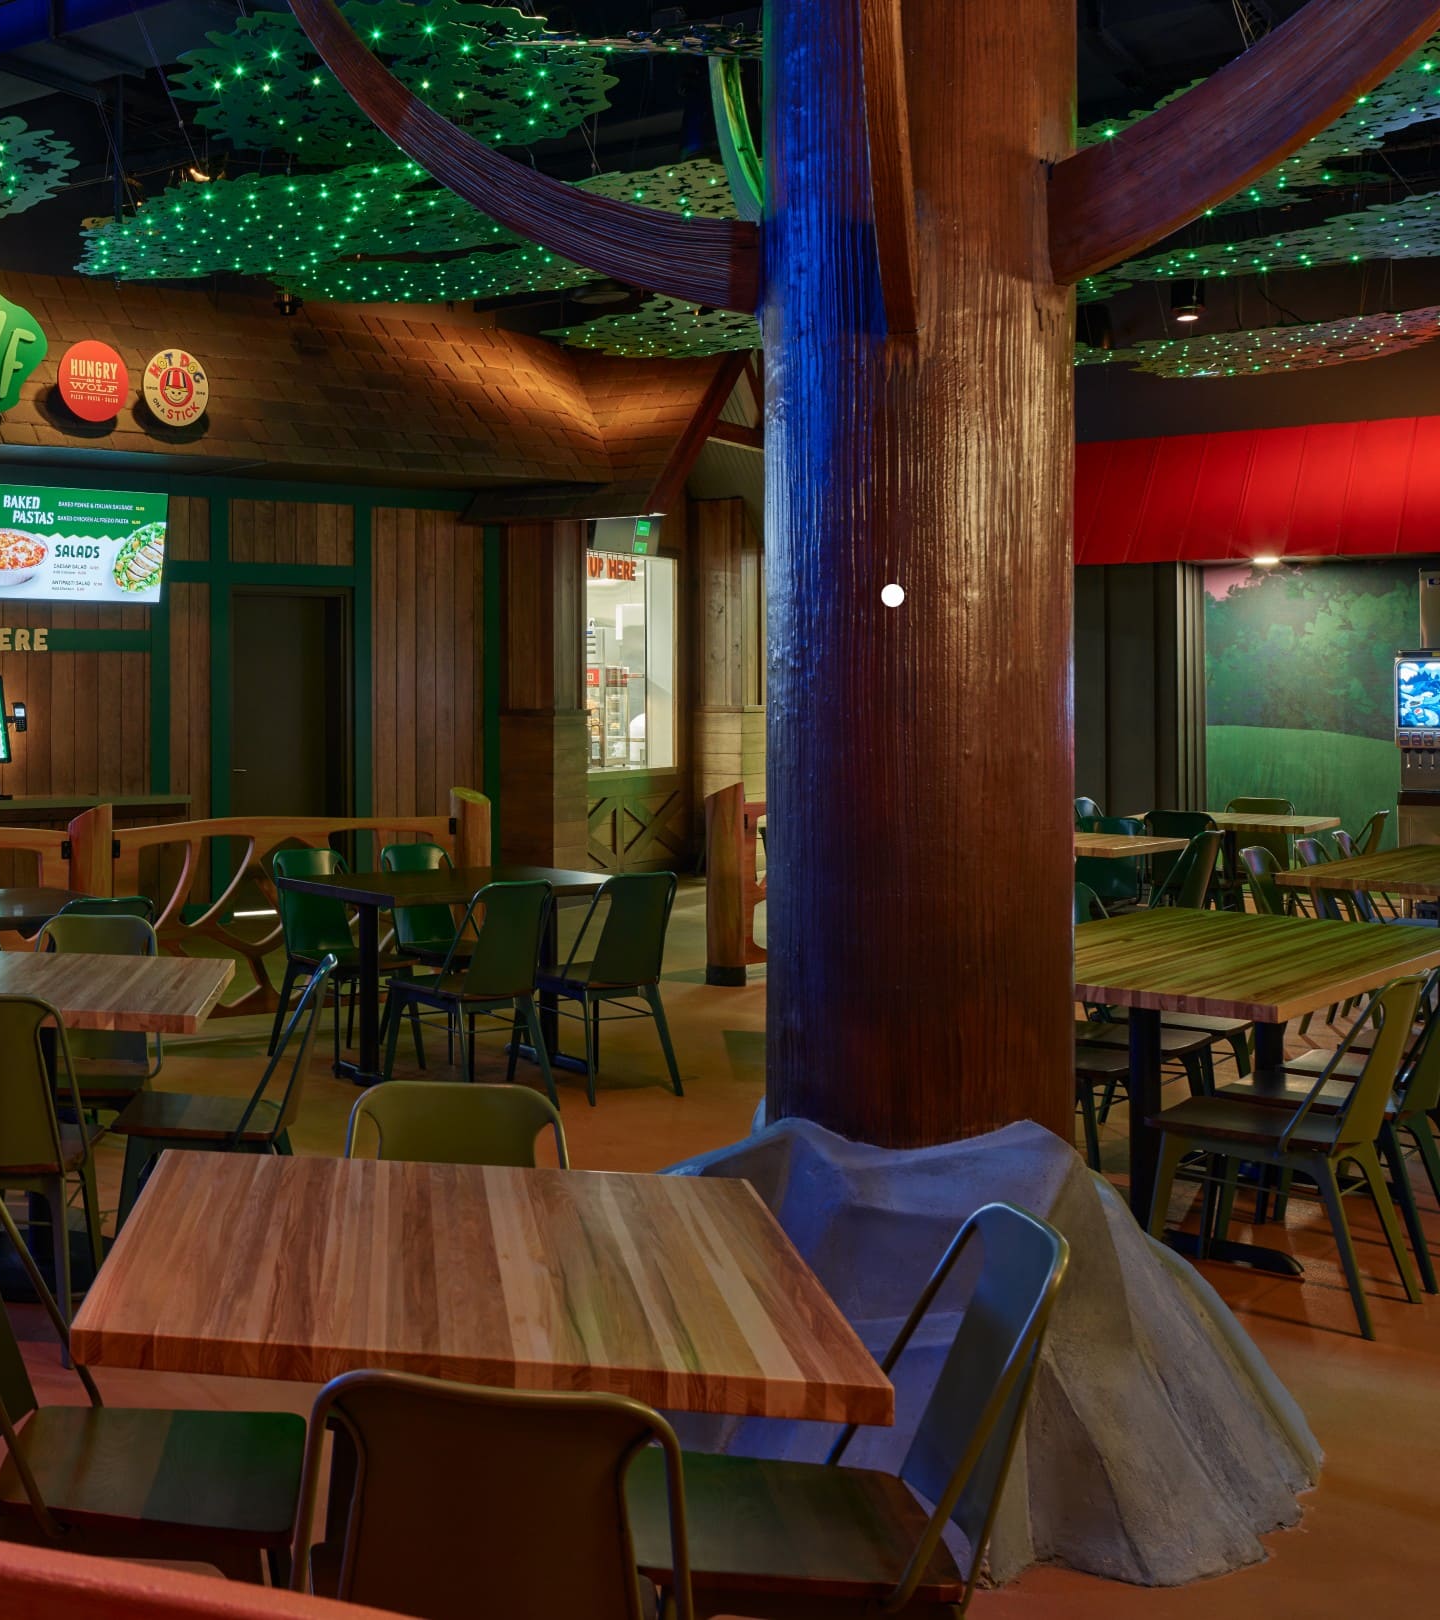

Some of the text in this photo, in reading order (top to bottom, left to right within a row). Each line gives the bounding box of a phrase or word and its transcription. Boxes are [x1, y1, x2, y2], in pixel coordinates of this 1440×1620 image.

[70, 358, 118, 380] HUNGRY
[148, 353, 205, 383] HOT DOG
[70, 381, 118, 393] WOLF
[167, 401, 200, 421] STICK
[3, 495, 40, 509] BAKED
[12, 510, 54, 525] PASTAS
[54, 544, 100, 559] SALADS
[587, 556, 637, 581] UP HERE
